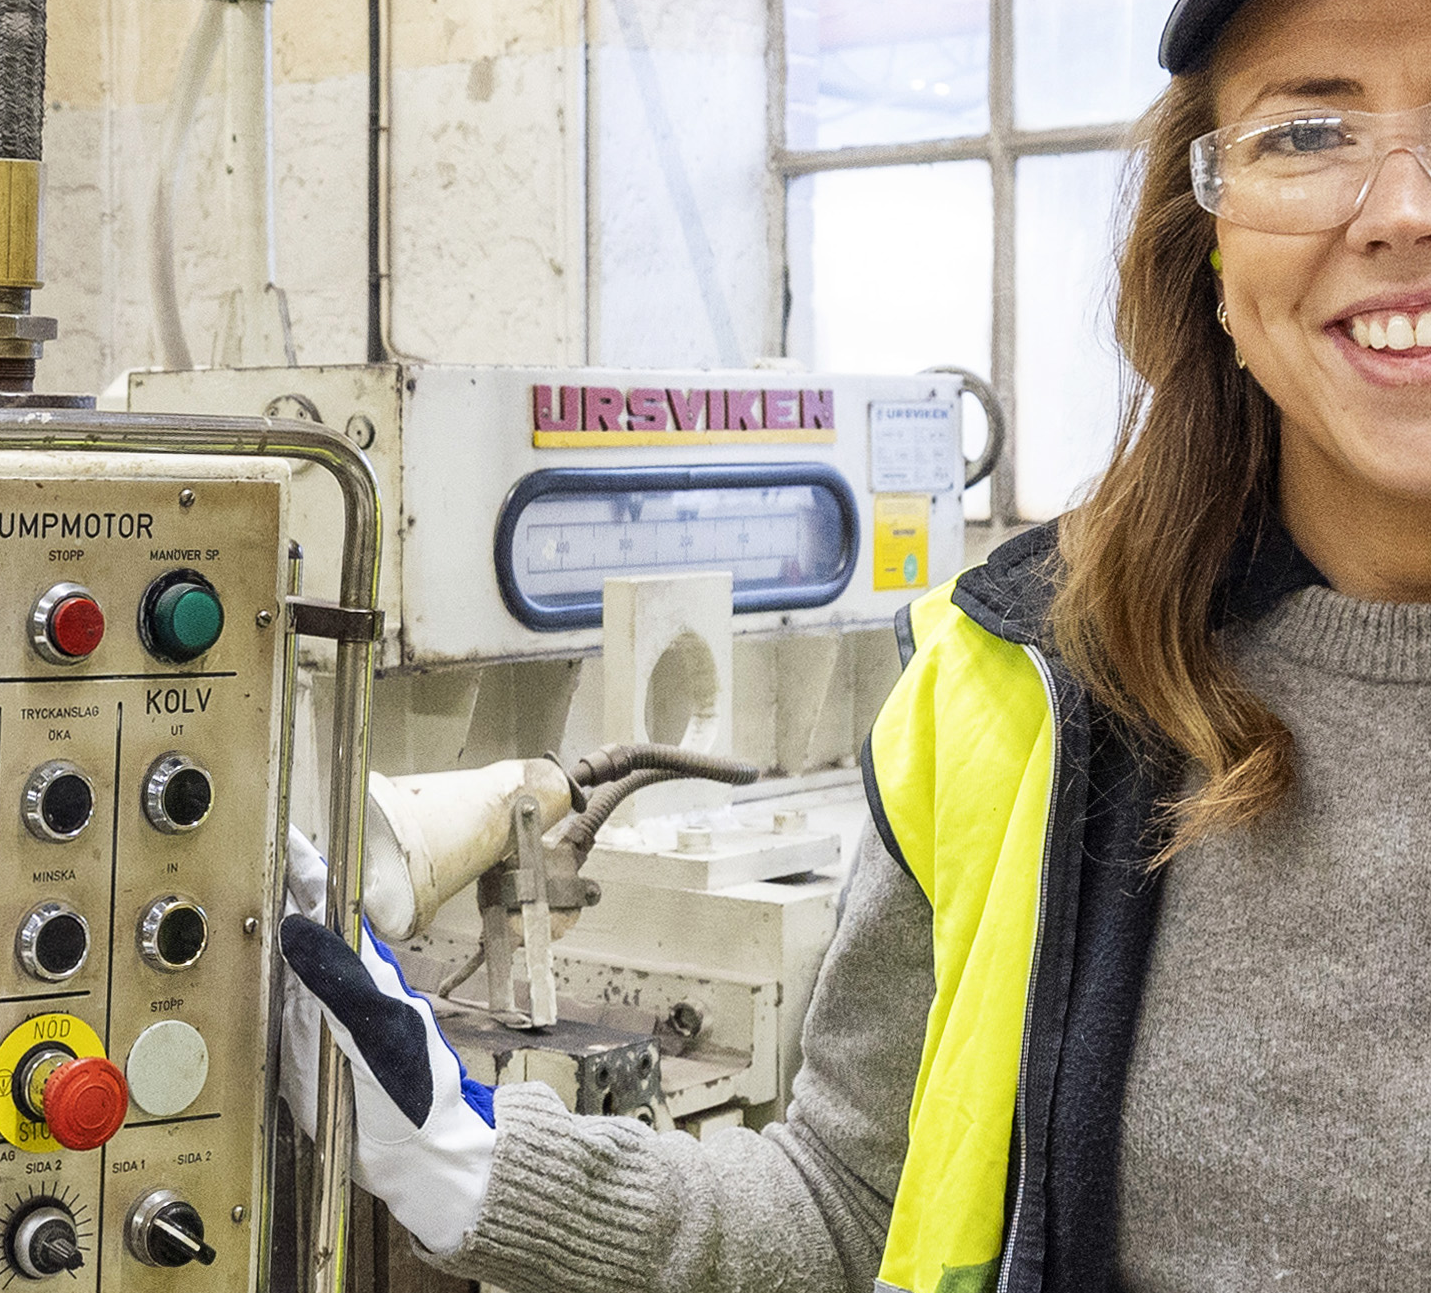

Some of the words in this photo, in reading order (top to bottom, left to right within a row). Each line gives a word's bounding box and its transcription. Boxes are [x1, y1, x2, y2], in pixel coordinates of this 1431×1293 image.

[534, 385, 834, 431] URSVIKEN
[48, 550, 84, 561] STOPP
[149, 549, 200, 561] MANÖVER
[145, 687, 212, 715] KOLV
[20, 706, 100, 721] TRYCKANSLAG
[48, 728, 72, 741] ÖKA
[170, 724, 184, 736] UT
[166, 862, 179, 875] IN
[32, 869, 77, 884] MINSKA
[150, 998, 185, 1014] STOPP
[33, 1017, 71, 1041] NÖD
[177, 1153, 203, 1167] SIDA
[206, 1151, 213, 1164] 2
[26, 1162, 53, 1175] SIDA
[55, 1160, 63, 1172] 2
[112, 1161, 138, 1175] SIDA
